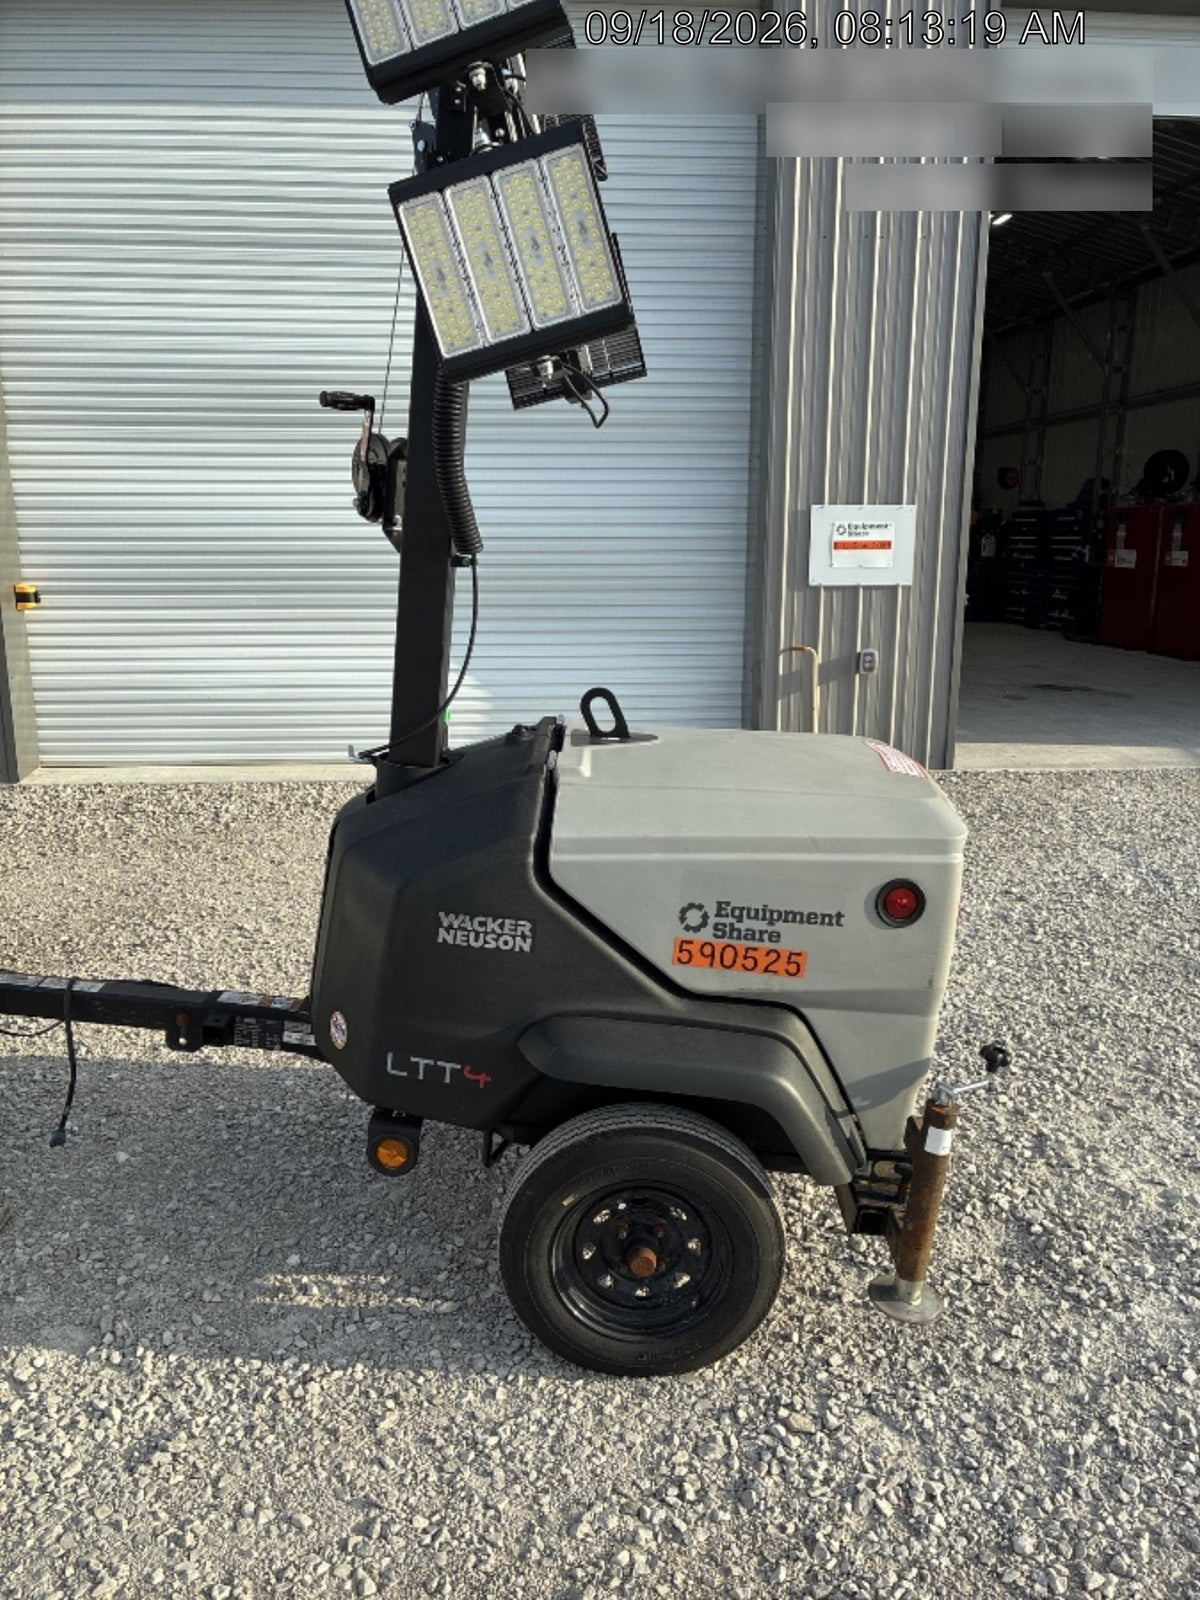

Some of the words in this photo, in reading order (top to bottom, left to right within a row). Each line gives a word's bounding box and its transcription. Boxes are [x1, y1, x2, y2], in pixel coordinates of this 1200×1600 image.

[438, 911, 533, 937] WACKER
[714, 900, 845, 927] Equipment
[437, 927, 533, 953] NEUSON
[712, 922, 782, 943] Share
[676, 940, 803, 977] 590525
[386, 1051, 492, 1089] LTT4
